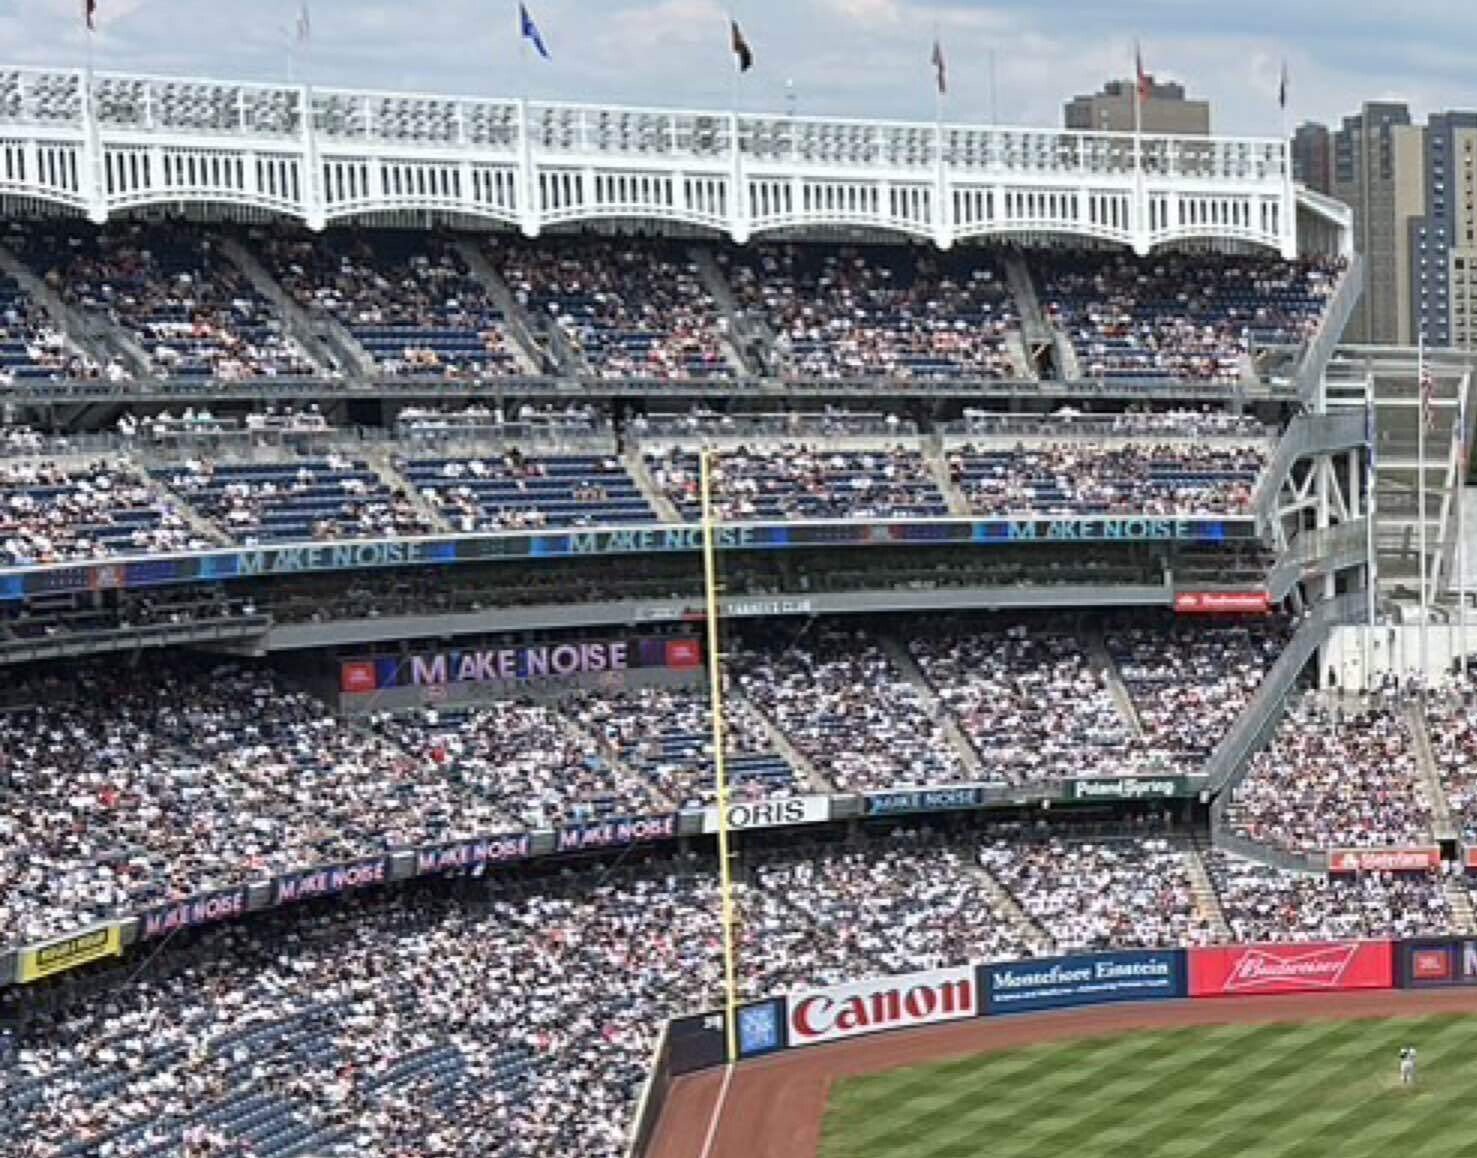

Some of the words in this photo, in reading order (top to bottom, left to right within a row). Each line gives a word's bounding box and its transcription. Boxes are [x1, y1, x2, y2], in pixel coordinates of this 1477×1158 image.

[569, 530, 656, 554] MAKE
[664, 527, 754, 549] NOSE
[1008, 521, 1094, 540] MAKE
[1102, 520, 1190, 540] NOISE
[237, 548, 322, 575] MAKE
[333, 542, 426, 568] NOISE
[412, 648, 518, 684] MAKE
[526, 641, 628, 676] NOISE
[730, 802, 806, 828] ORIS
[993, 965, 1091, 991] Montefiore
[1237, 957, 1347, 979] Budweiser
[791, 975, 972, 1038] Canon
